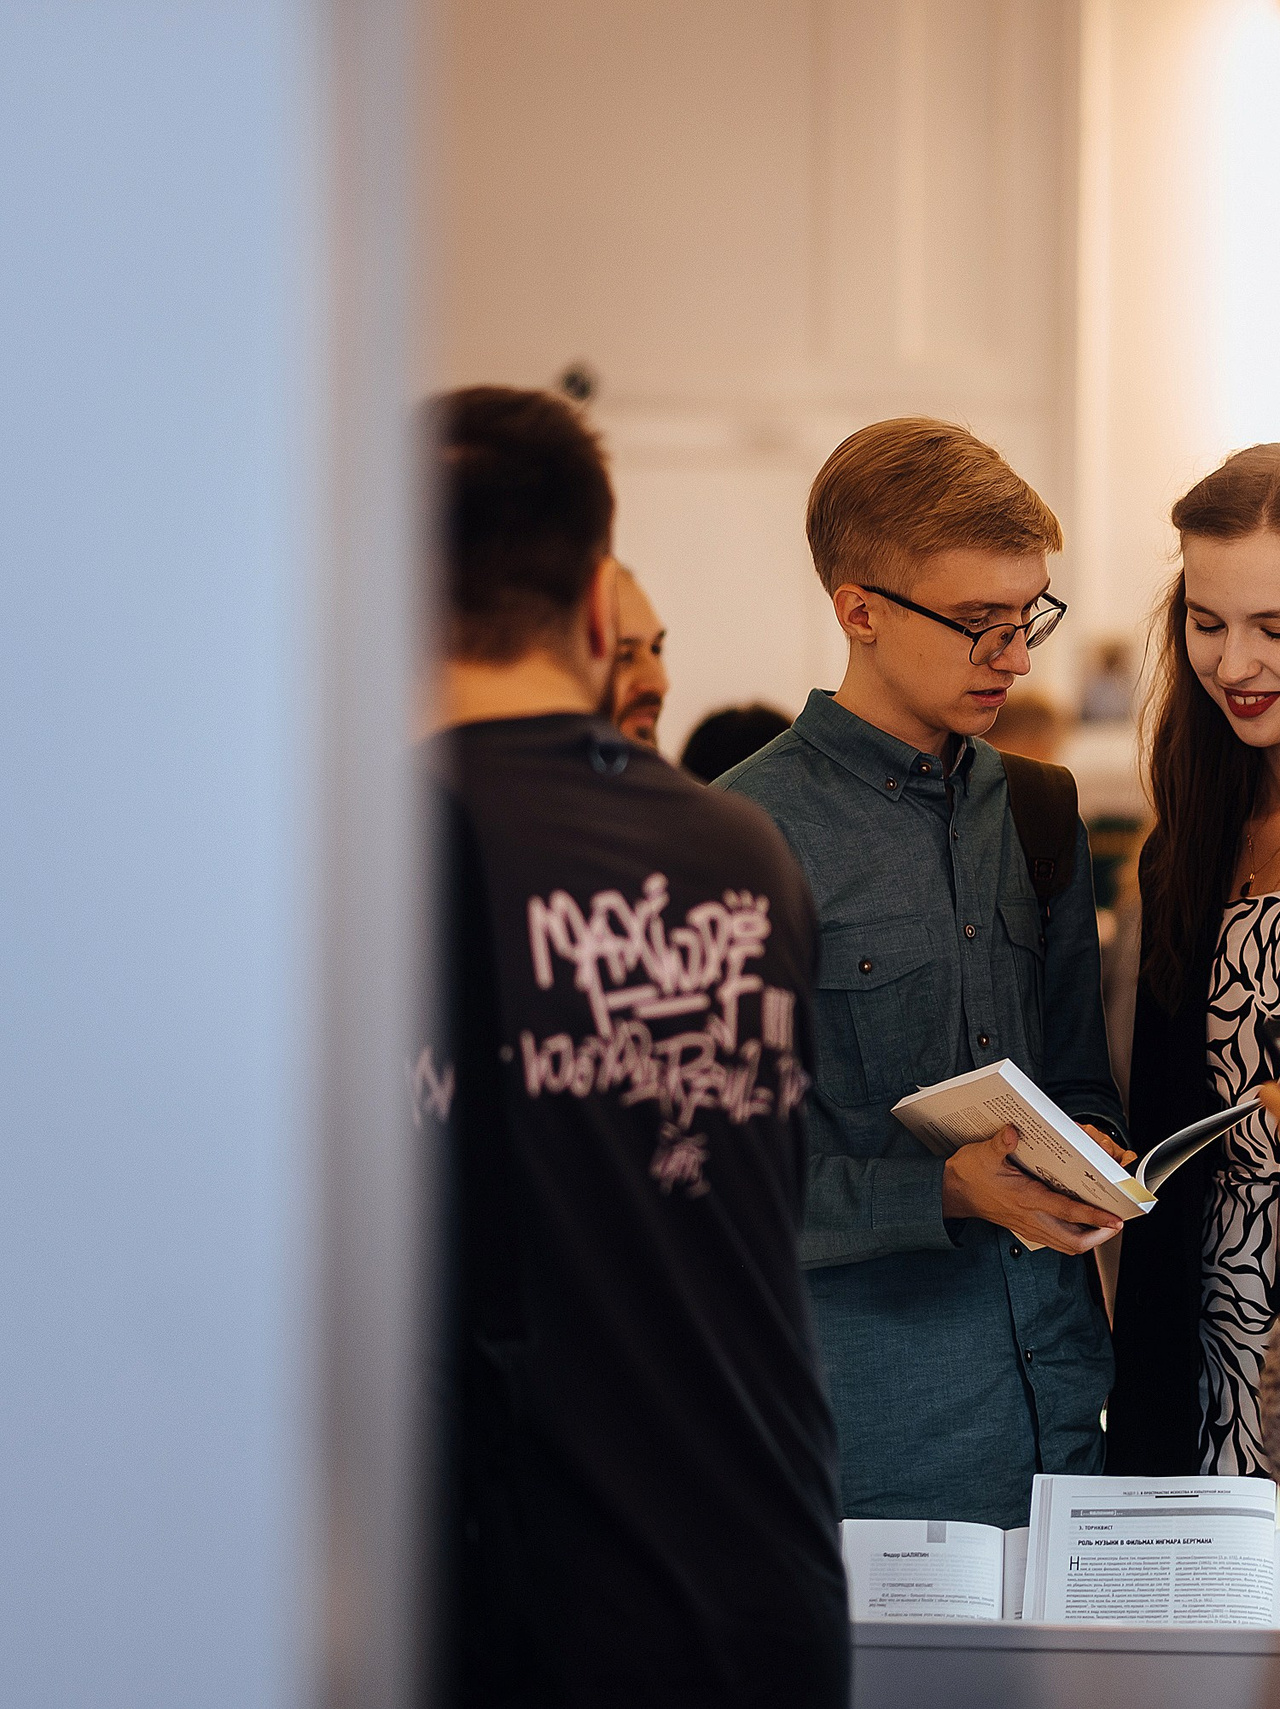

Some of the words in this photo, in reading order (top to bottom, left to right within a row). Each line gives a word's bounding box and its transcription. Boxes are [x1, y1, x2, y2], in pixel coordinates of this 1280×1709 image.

[995, 1097, 1018, 1117] работ
[1027, 1126, 1066, 1163] творчестве
[1006, 1093, 1042, 1128] Открытый
[1043, 1130, 1073, 1158] конкурс
